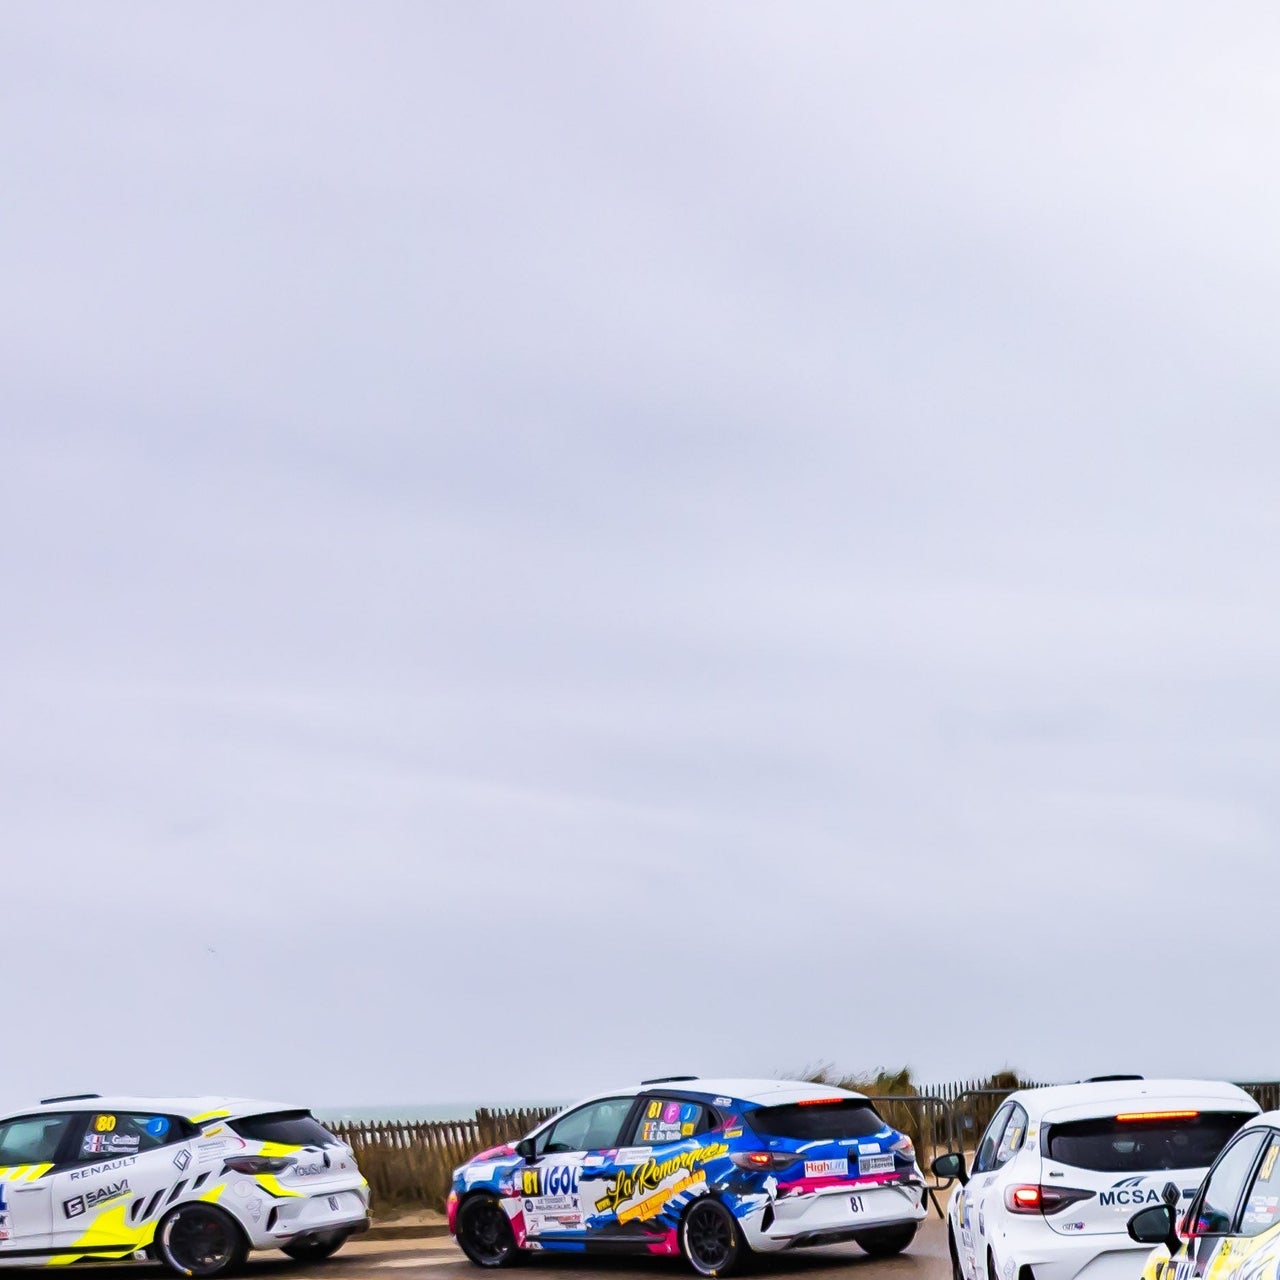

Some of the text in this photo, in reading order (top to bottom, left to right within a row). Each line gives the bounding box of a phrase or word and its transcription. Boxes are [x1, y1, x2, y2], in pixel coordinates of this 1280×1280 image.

[648, 1101, 662, 1118] 81
[95, 1115, 117, 1132] 80
[70, 1156, 139, 1182] RENAULT
[543, 1166, 579, 1197] IGOL
[86, 1179, 131, 1204] SALVI
[1100, 1189, 1160, 1206] MCSA
[849, 1196, 865, 1213] 81
